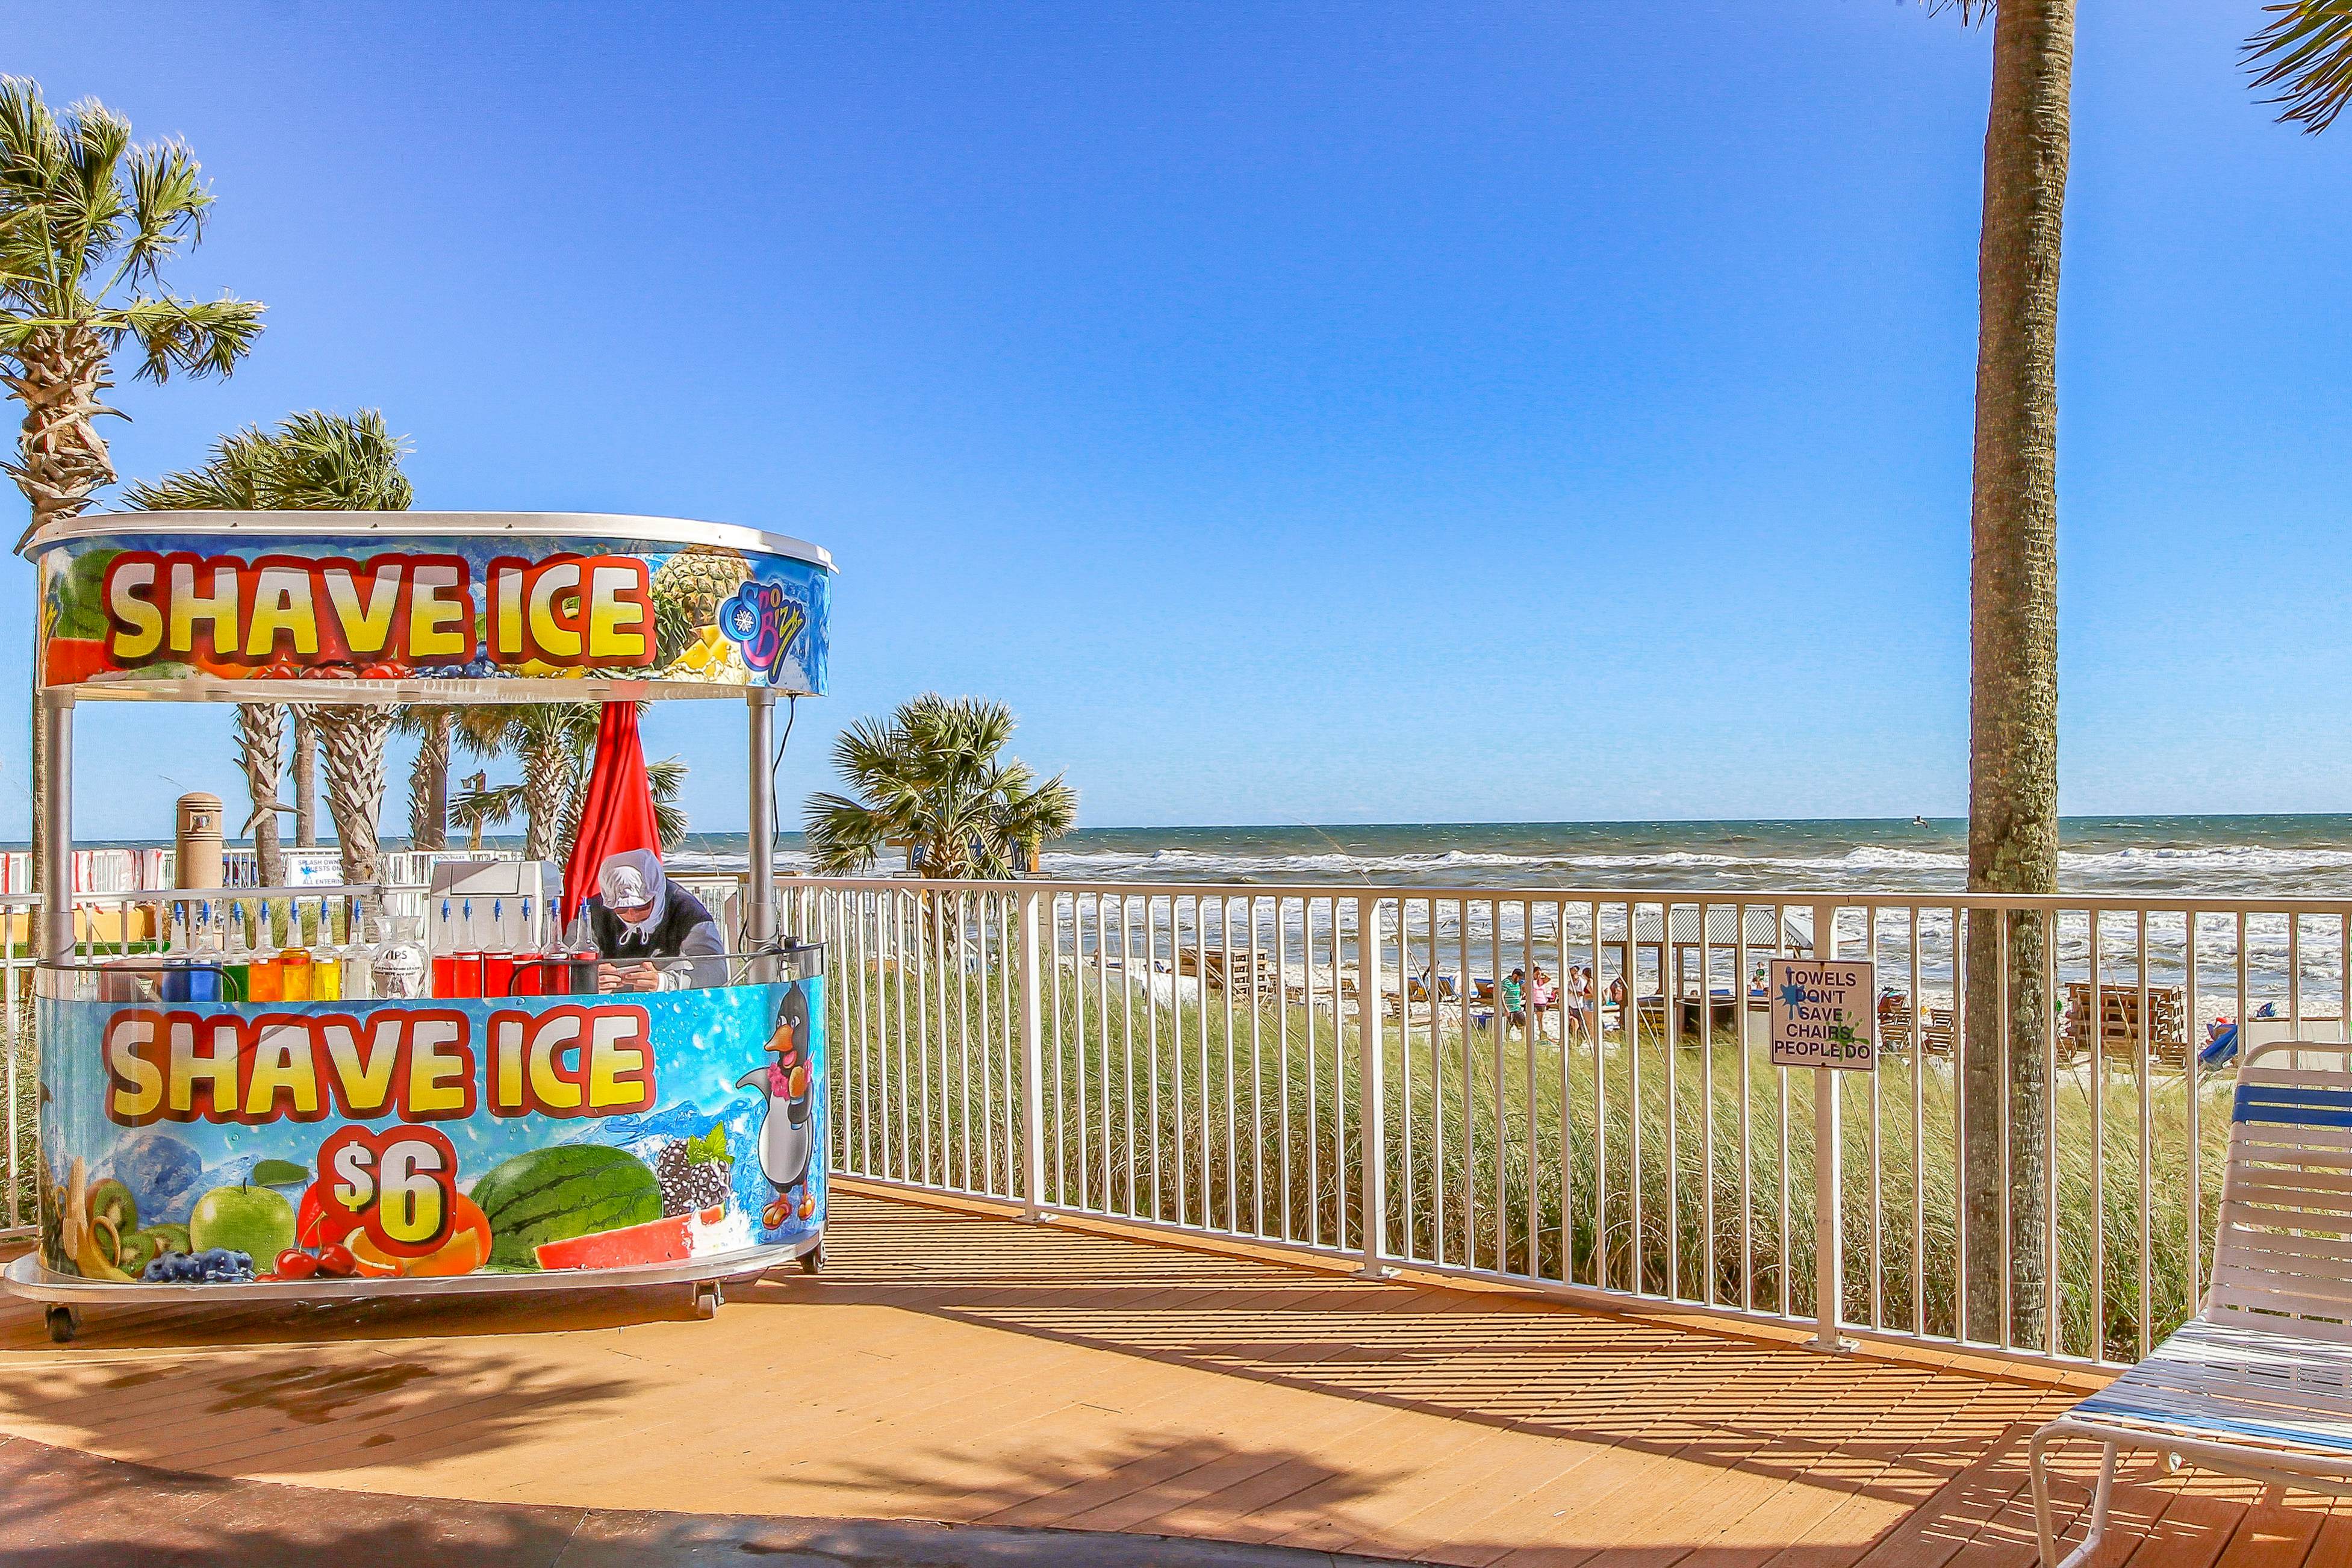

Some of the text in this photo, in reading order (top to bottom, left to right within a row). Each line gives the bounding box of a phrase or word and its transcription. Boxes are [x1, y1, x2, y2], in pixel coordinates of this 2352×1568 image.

[110, 562, 645, 658] SHAVE ICE
[1786, 971, 1856, 987] TOWELS
[1796, 989, 1846, 1004] DON'T
[1799, 1006, 1844, 1022] SAVE
[1775, 1040, 1870, 1059] PEOPLE DO
[110, 1015, 645, 1116] SHAVE ICE
[333, 1140, 441, 1242] $6
